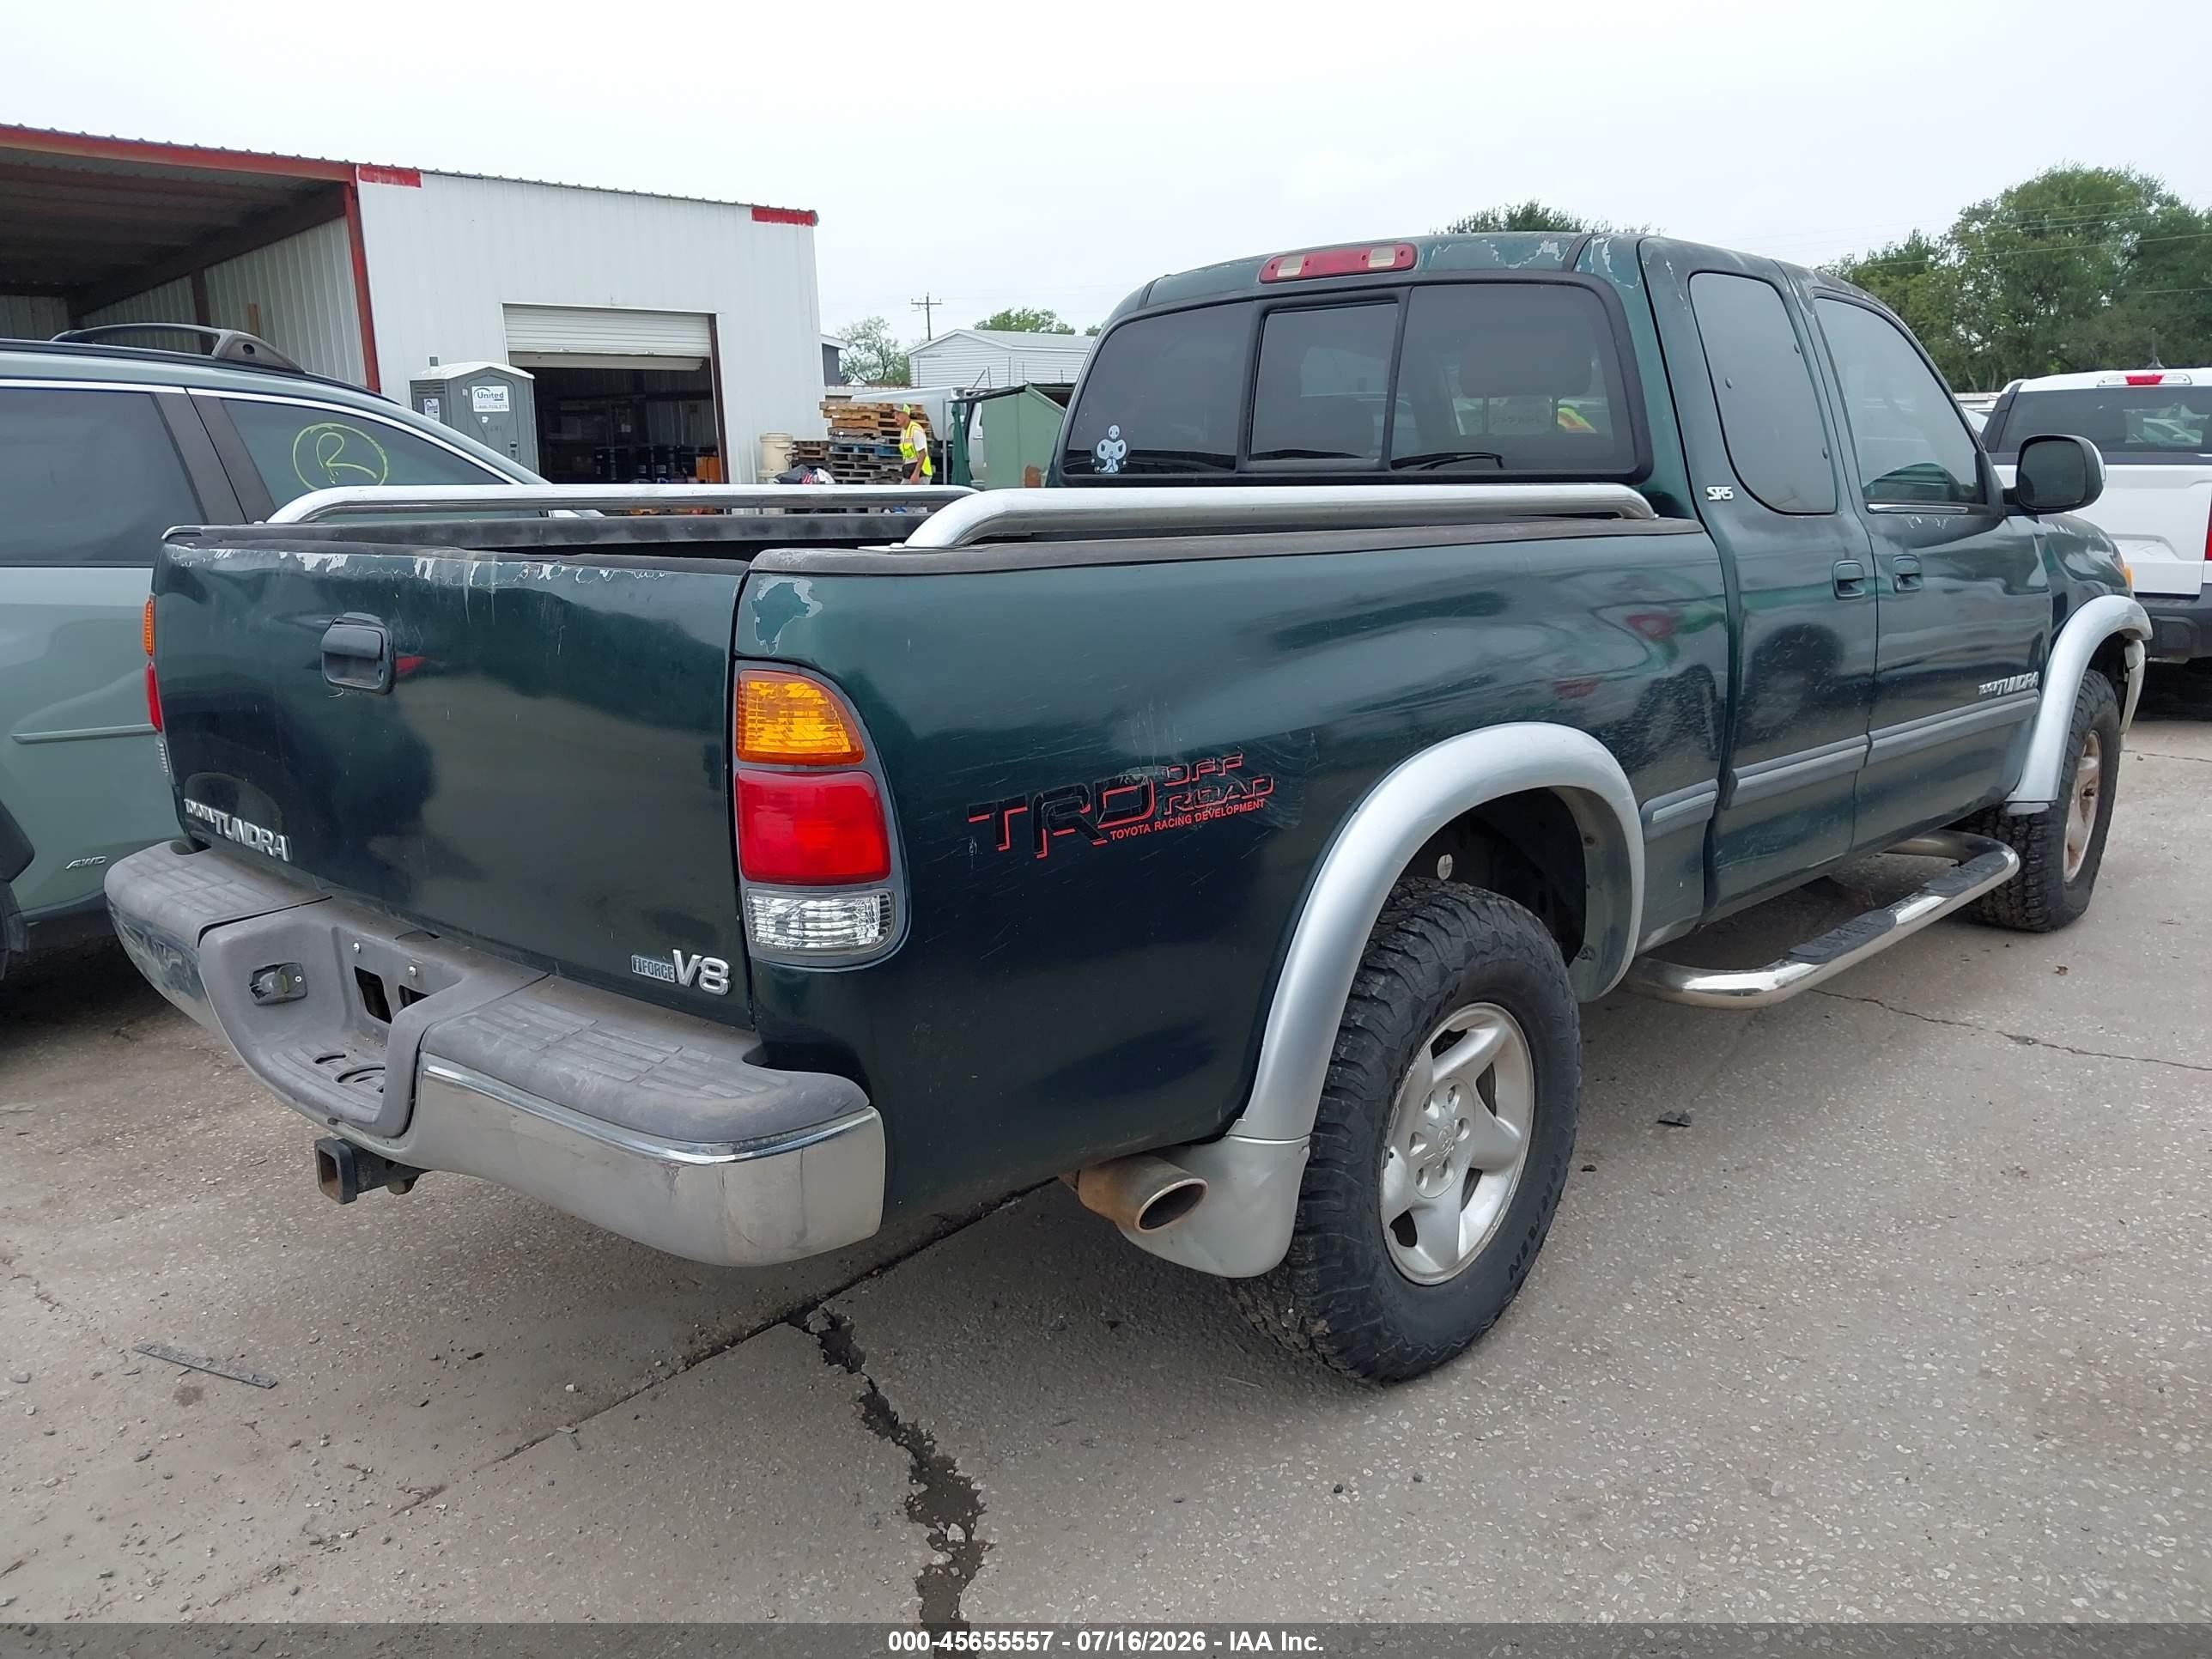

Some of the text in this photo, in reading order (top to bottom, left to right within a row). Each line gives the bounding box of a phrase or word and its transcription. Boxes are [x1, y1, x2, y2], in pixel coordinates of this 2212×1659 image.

[477, 391, 504, 399] United
[1706, 485, 1735, 501] SR5
[1163, 752, 1244, 787] OFF
[1164, 775, 1274, 816] ROAD
[213, 808, 291, 862] TUNDRA
[967, 775, 1156, 859] TRD
[1110, 799, 1266, 841] TOYOTA RACING DEVELOPMENT
[672, 949, 729, 996] V8
